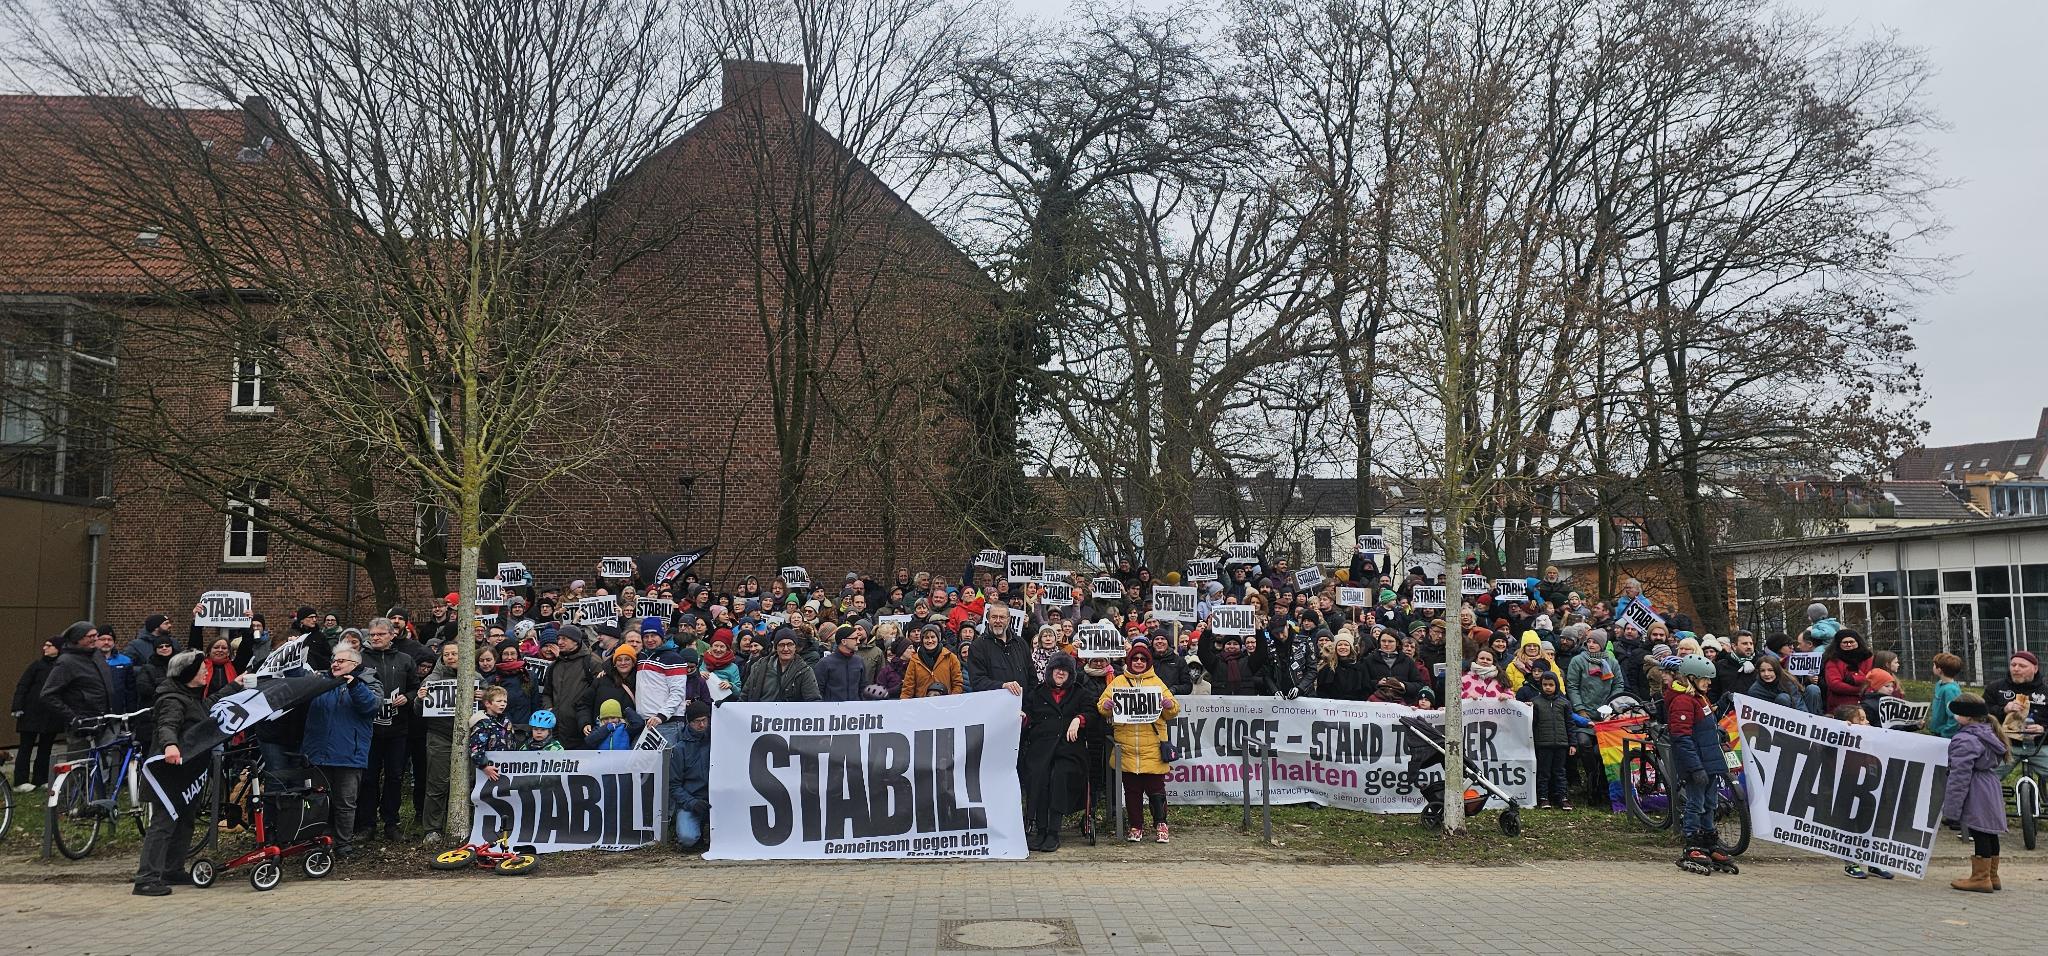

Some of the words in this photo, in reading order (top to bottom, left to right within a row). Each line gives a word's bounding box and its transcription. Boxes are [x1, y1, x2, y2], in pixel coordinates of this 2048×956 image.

[1010, 562, 1044, 577] STABIL!
[1188, 562, 1217, 576] STABIL!
[1297, 569, 1320, 585] STABIL!
[1155, 593, 1195, 612] STABIL!
[1341, 591, 1364, 602] STABIL!
[637, 600, 672, 617] STABIL!
[1212, 610, 1255, 629] STABIL!
[1790, 656, 1821, 671] STABIL!
[1271, 705, 1317, 715] Сплотени
[1880, 701, 1929, 724] STABIL!
[750, 714, 825, 733] Bremen
[829, 713, 884, 732] bleibt
[1740, 704, 1807, 737] Bremen
[1810, 724, 1863, 749] bleibt
[1167, 717, 1207, 760] TAY
[1214, 716, 1279, 757] CLOSE
[1310, 720, 1383, 764] STAND
[540, 759, 580, 773] bleibt
[1164, 757, 1358, 788] sammenhalten
[748, 724, 988, 846] STABIL!
[1740, 723, 1948, 849] STABIL!
[1333, 792, 1367, 804] siempre
[1370, 795, 1397, 804] unidos
[480, 772, 655, 846] STABIL!
[824, 838, 910, 854] Gemeinsam
[913, 835, 958, 853] gegen
[961, 832, 989, 846] den
[1793, 818, 1870, 849] Demokratie
[1871, 839, 1927, 862] schütze
[1773, 826, 1853, 859] Gemeinsam.
[1854, 847, 1922, 875] Solidarisc
